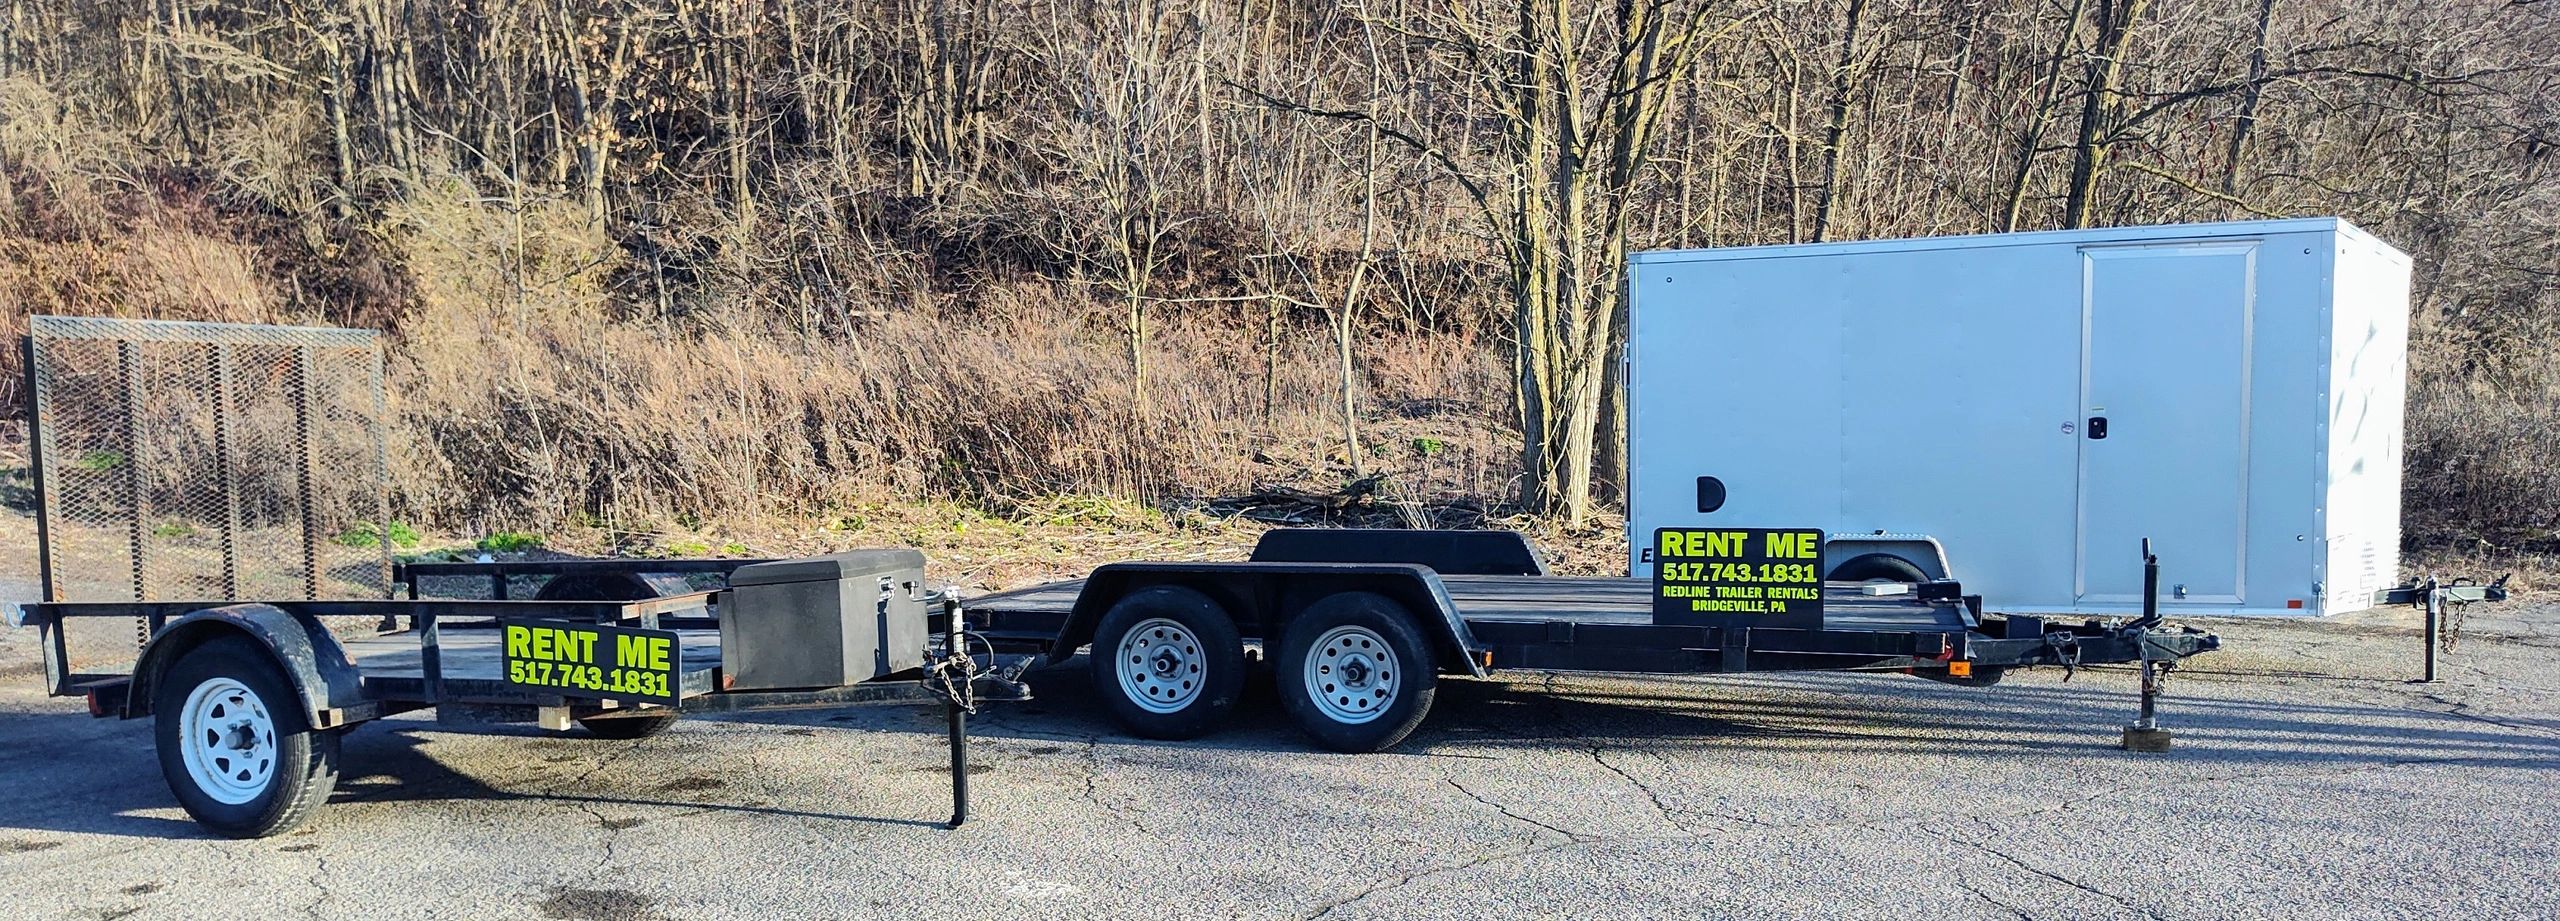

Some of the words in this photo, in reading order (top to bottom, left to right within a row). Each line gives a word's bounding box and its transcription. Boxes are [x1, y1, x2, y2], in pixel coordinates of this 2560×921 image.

[1661, 531, 1748, 557] RENT
[1766, 532, 1818, 559] ME
[1662, 562, 1818, 583] 517.743.1831
[1663, 585, 1711, 598] REDLINE
[1715, 586, 1763, 599] TRAILER
[1767, 587, 1819, 600] RENTALS
[1692, 600, 1768, 614] BRIDGEVILLE,
[1770, 601, 1787, 613] PA
[507, 625, 599, 664] RENT
[617, 634, 671, 671] ME
[510, 660, 671, 698] 517.743.1831
